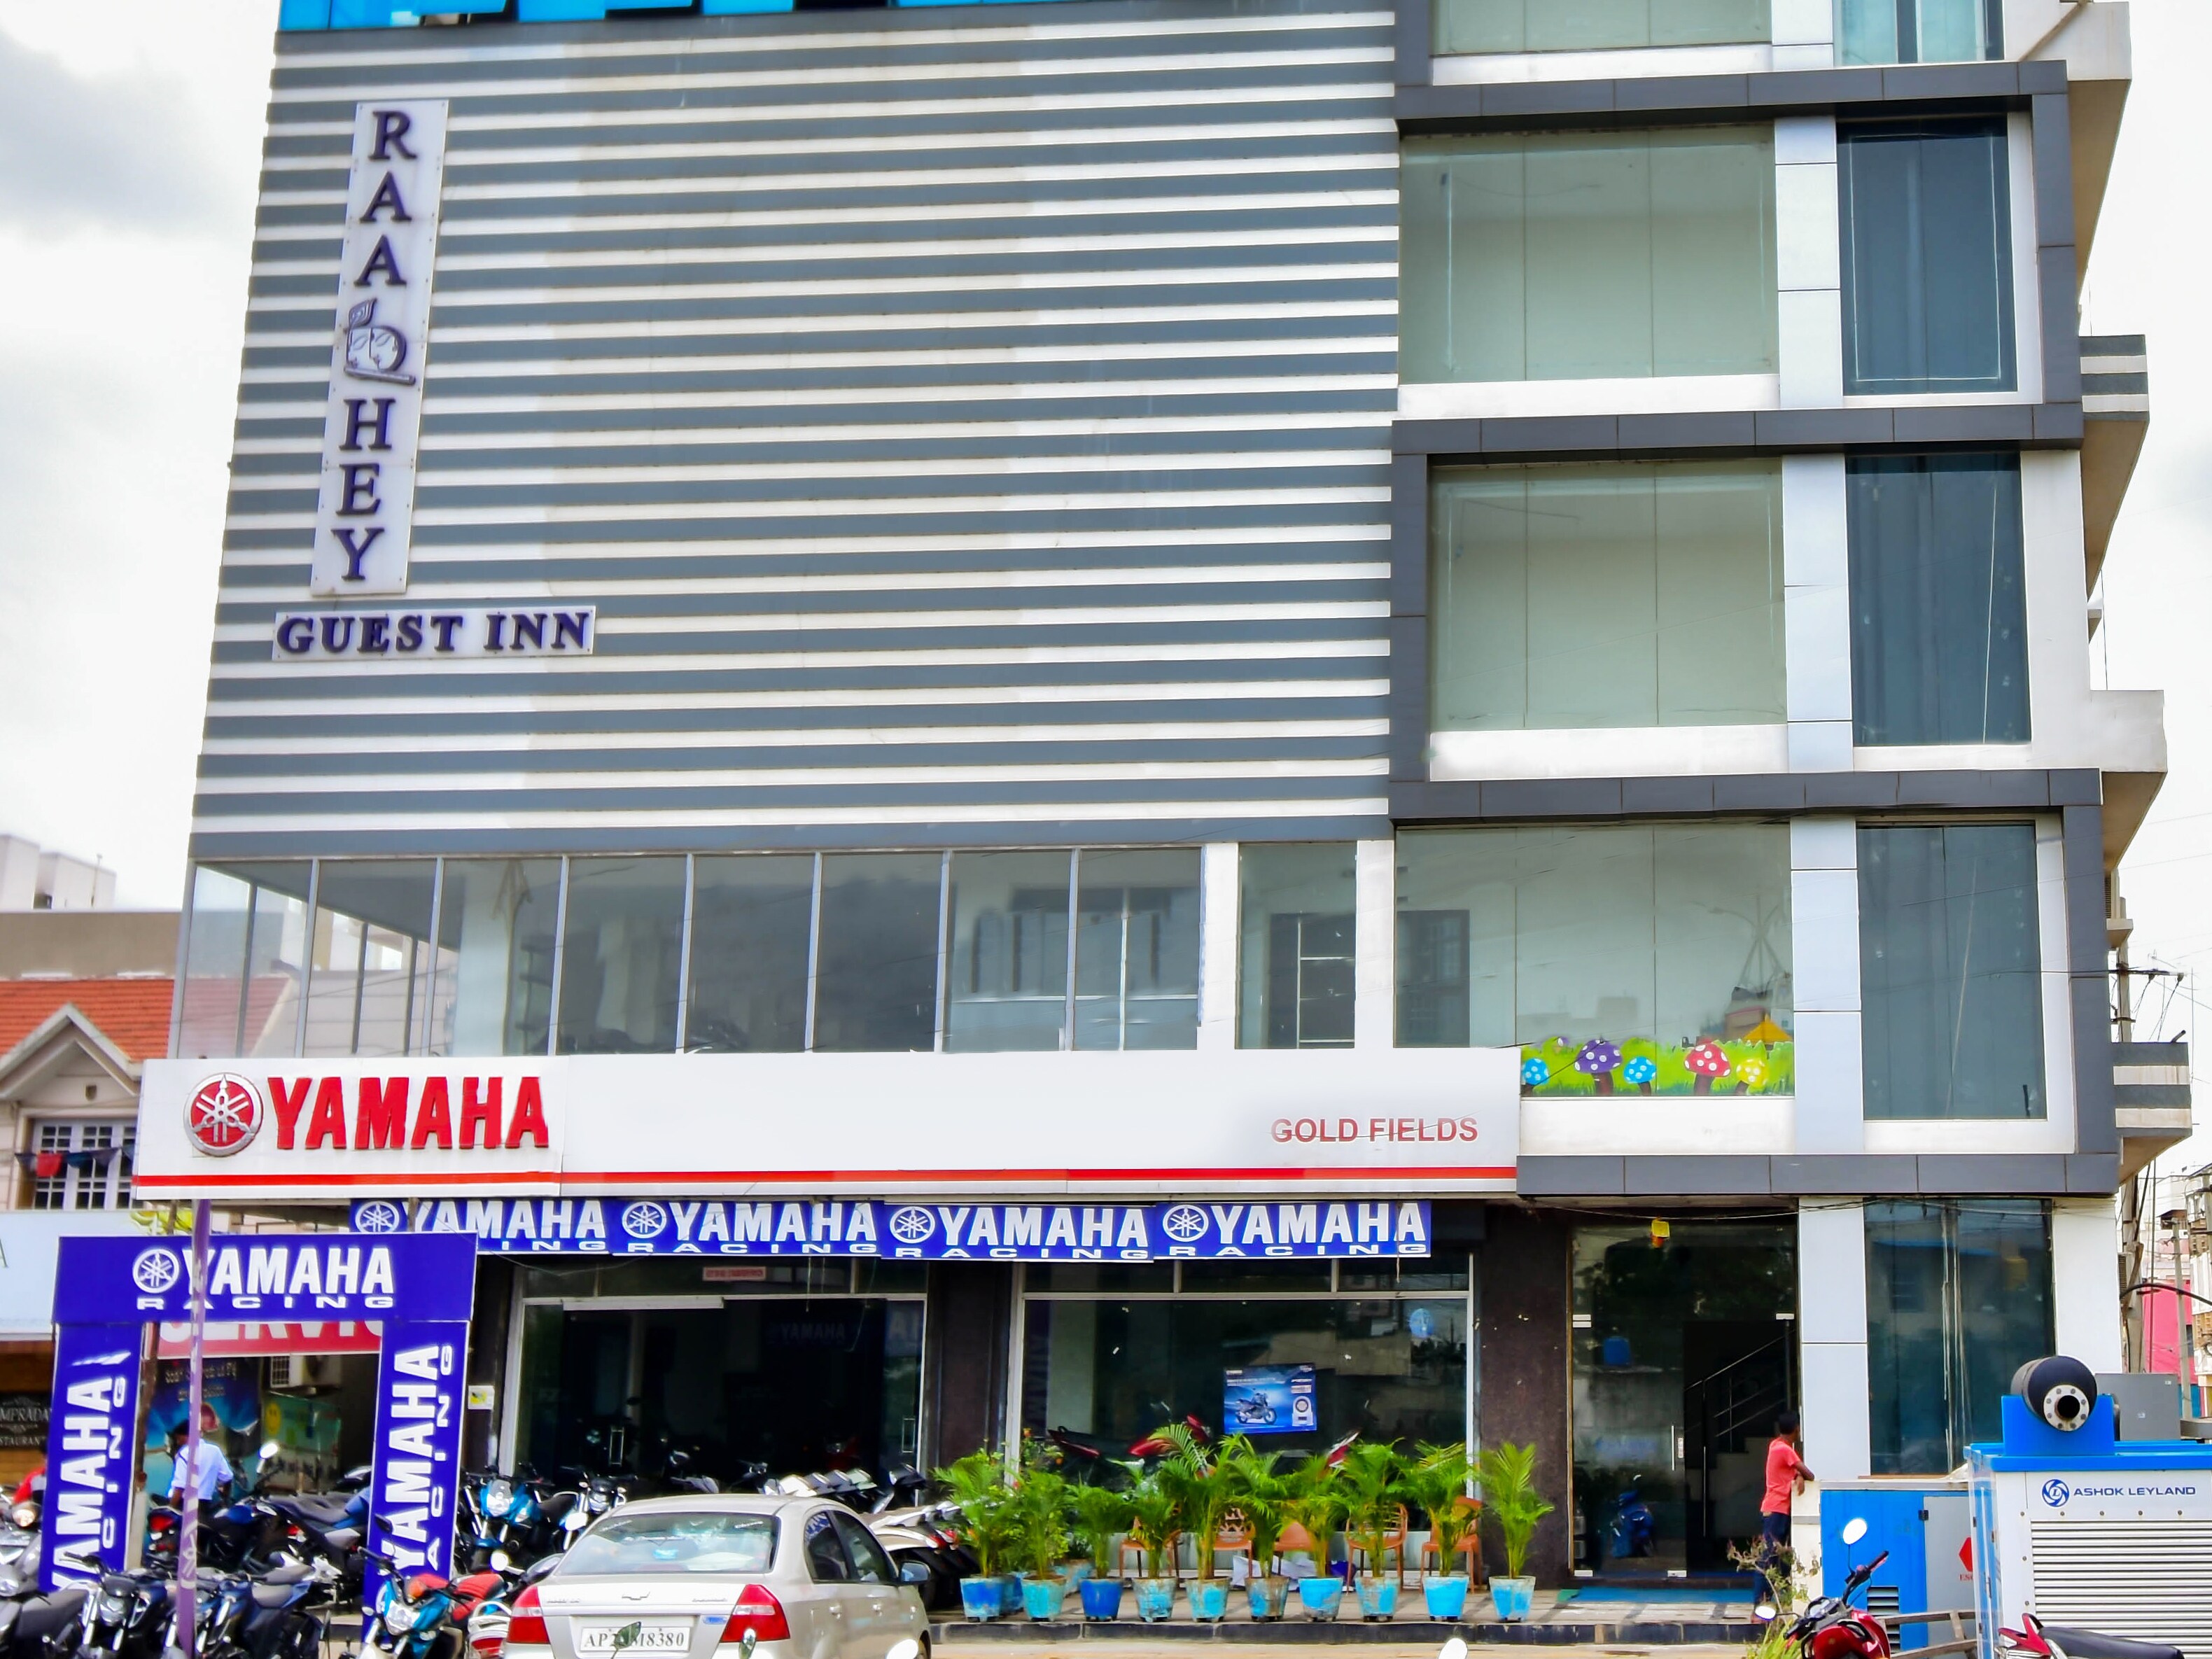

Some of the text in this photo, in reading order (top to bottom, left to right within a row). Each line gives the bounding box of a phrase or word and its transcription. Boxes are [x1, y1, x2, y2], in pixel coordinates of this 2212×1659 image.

[276, 611, 589, 654] GUEST INN
[267, 1077, 550, 1150] YAMAHA
[1271, 1117, 1478, 1143] GOLD FIELDS
[401, 1199, 606, 1238] YAMAHA
[668, 1202, 877, 1242] YAMAHA
[937, 1207, 1149, 1247] YAMAHA
[1210, 1203, 1426, 1245] YAMAHA
[629, 1242, 877, 1254] RACING
[895, 1247, 1149, 1259] RACING
[1169, 1244, 1427, 1256] RACING
[182, 1247, 394, 1295] YAMAHA
[136, 1296, 394, 1310] RACING
[382, 1345, 440, 1570] YAMAHA
[2073, 1486, 2197, 1497] ASHOK LEYLAND
